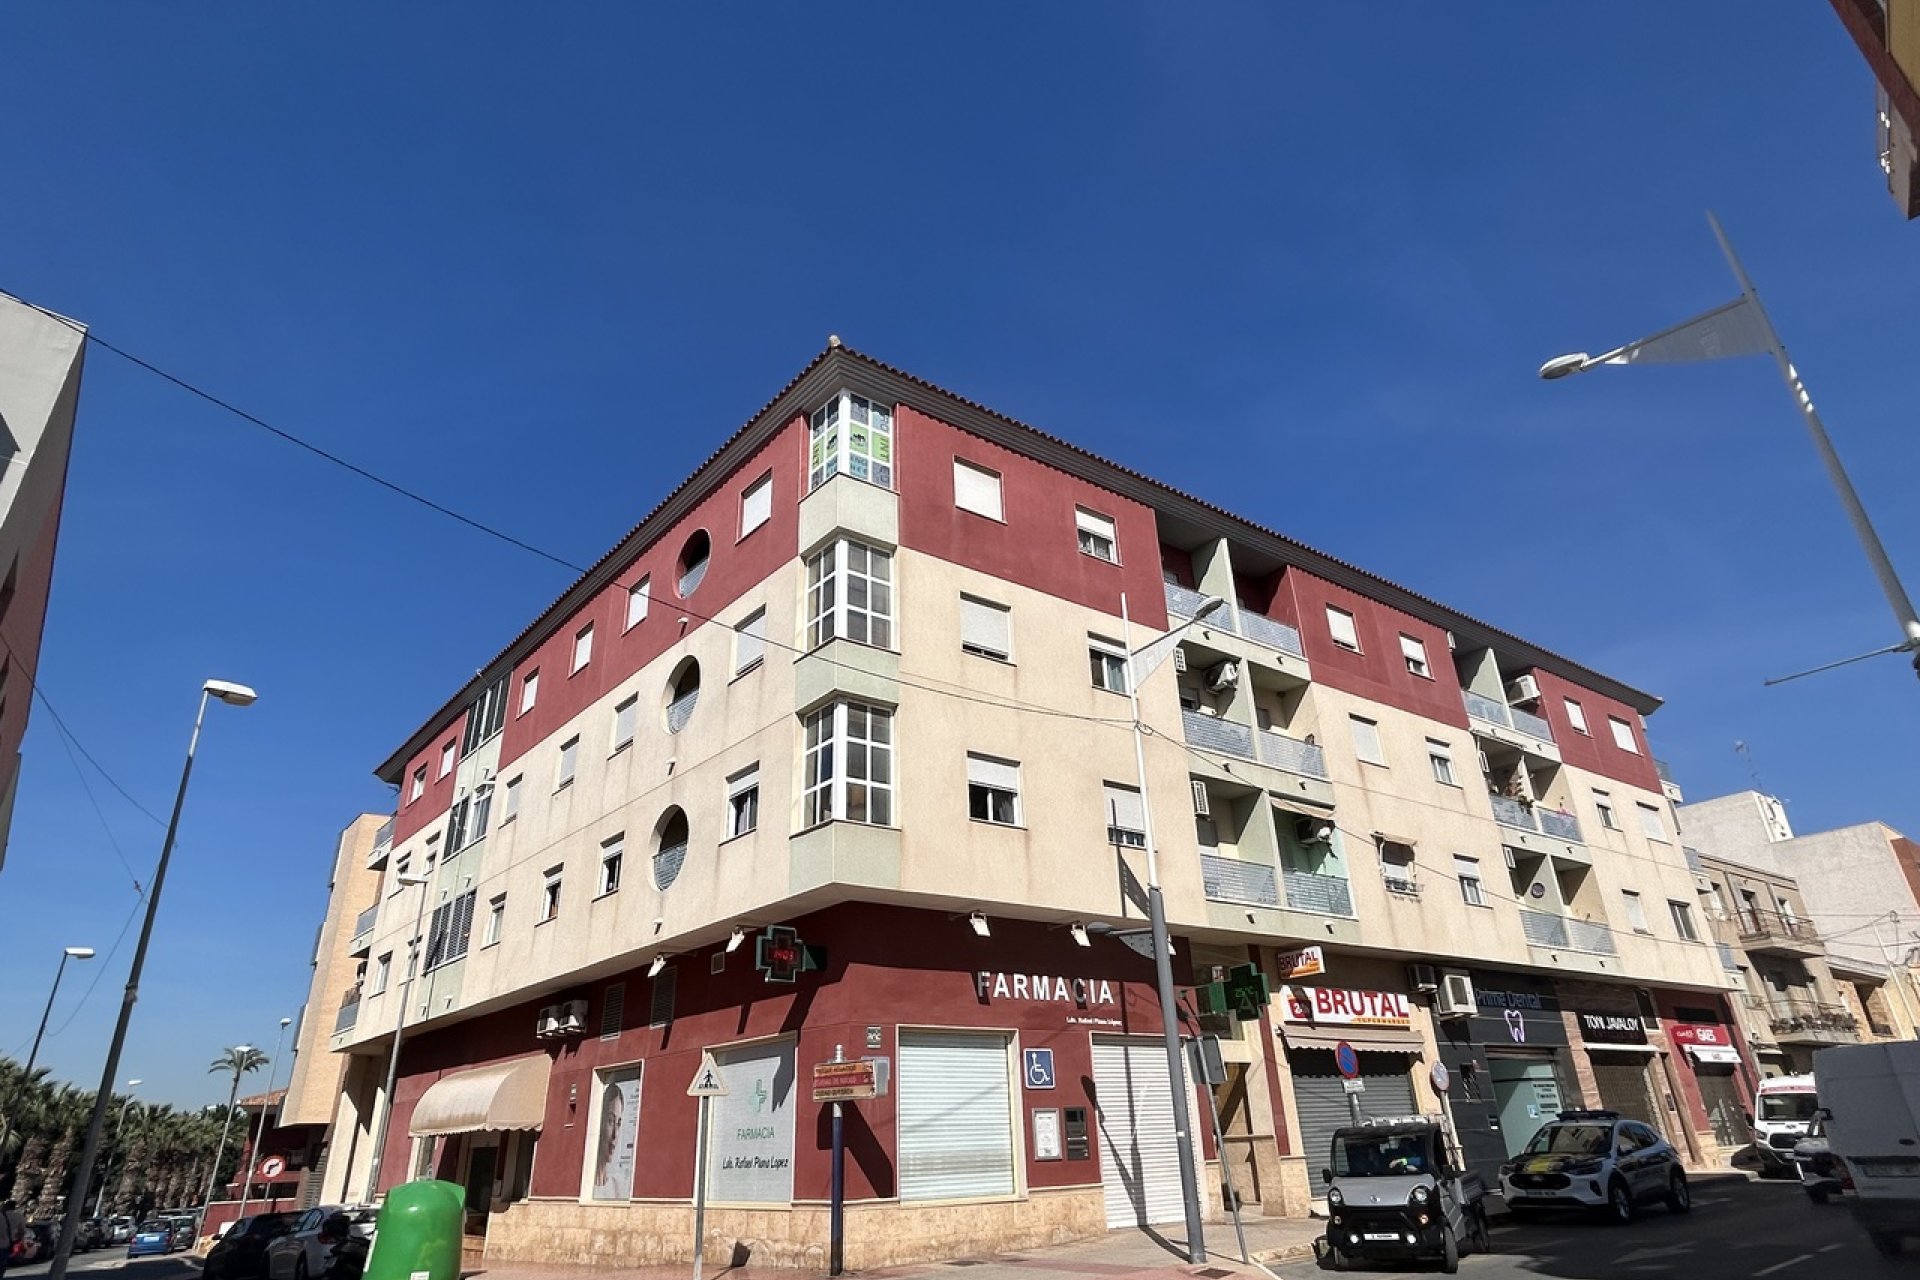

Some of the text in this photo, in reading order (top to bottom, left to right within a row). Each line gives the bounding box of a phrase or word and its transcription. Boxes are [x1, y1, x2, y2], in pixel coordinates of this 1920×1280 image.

[1279, 951, 1319, 970] BRUTAL
[977, 970, 1114, 1004] FARMACIA
[1314, 986, 1409, 1018] BRUTAL
[1474, 987, 1542, 1010] Prime Dental
[1584, 1014, 1605, 1030] TONI
[737, 1127, 775, 1140] FARMACIA
[735, 1155, 753, 1169] Rafael
